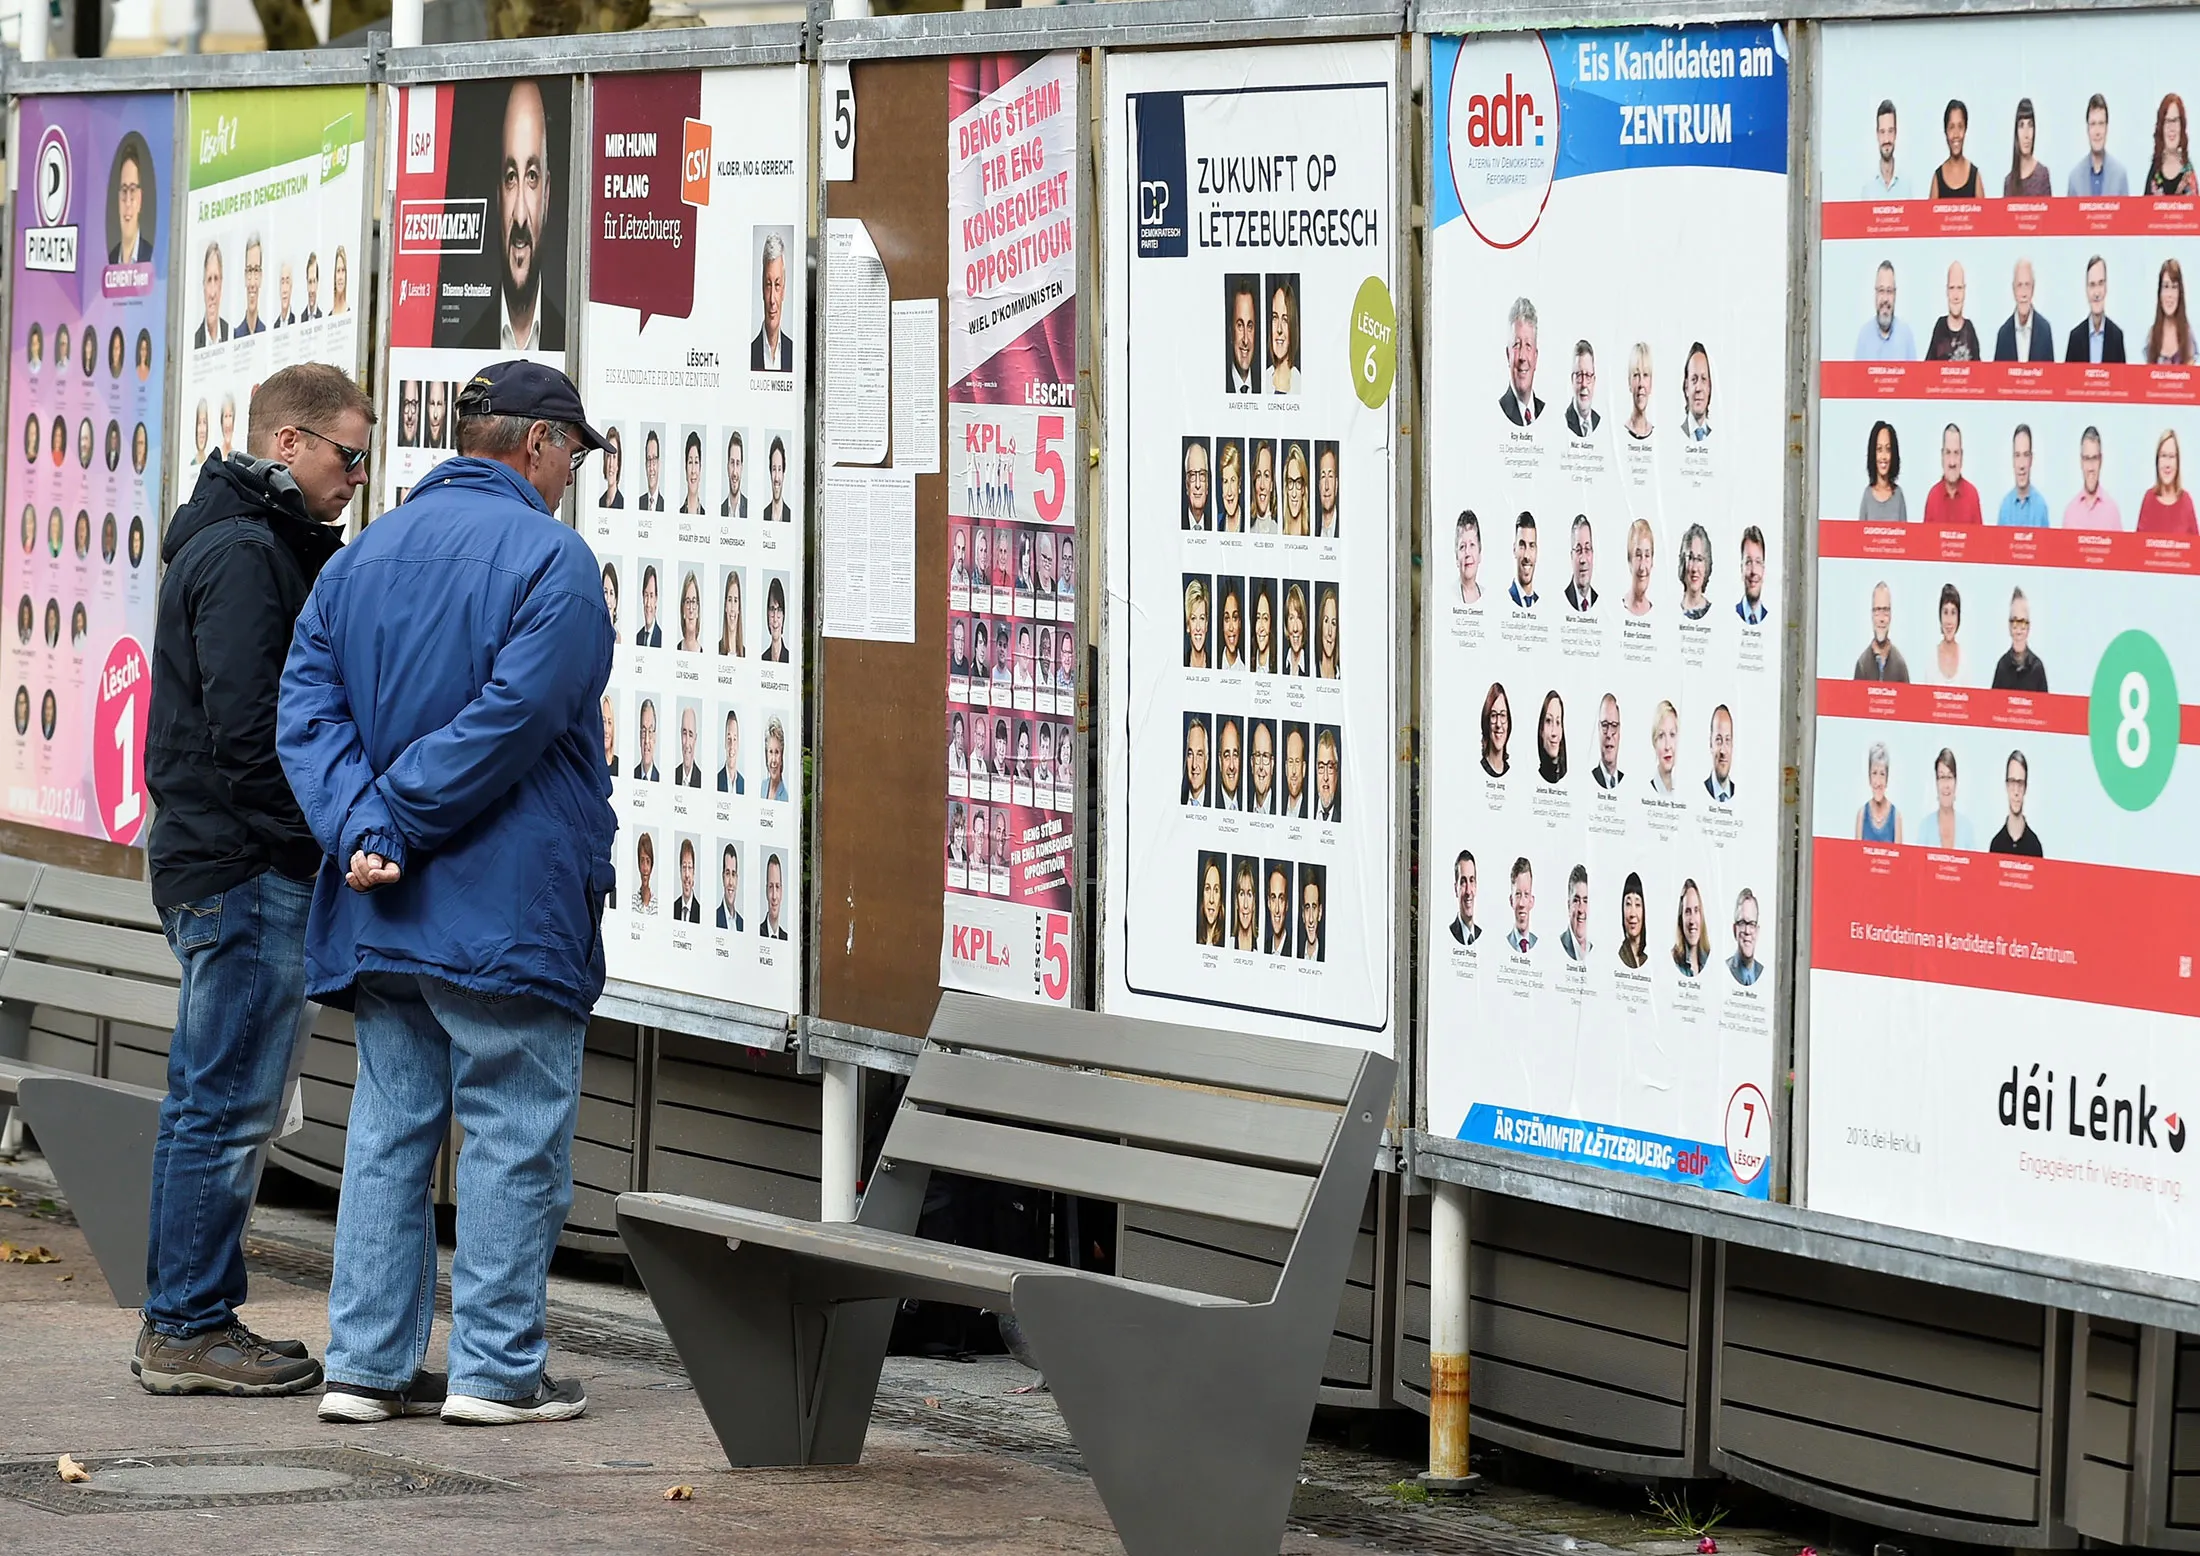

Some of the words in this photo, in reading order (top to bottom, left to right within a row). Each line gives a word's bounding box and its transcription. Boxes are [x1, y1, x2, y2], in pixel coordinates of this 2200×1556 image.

[1578, 42, 1609, 82] Eis
[1614, 38, 1734, 81] Kandidaten
[1739, 46, 1774, 78] am
[834, 89, 851, 150] 5
[959, 108, 1002, 161] DENG
[1005, 78, 1062, 137] STËMM
[1619, 103, 1732, 145] ZENTRUM
[410, 132, 432, 157] LSAP
[605, 133, 626, 158] MIR
[625, 132, 657, 158] HUNN
[685, 146, 710, 183] CSV
[717, 160, 742, 178] KLOER,
[742, 160, 754, 176] NO
[754, 161, 760, 175] &
[761, 160, 795, 176] GERECHT.
[981, 153, 1008, 197] FIR
[1010, 136, 1044, 182] ENG
[1197, 154, 1298, 194] ZUKUNFT
[1306, 153, 1337, 192] OP
[604, 174, 612, 199] E
[612, 173, 650, 199] PLANG
[1140, 181, 1169, 226] DP
[198, 201, 210, 223] ÄR
[210, 194, 239, 218] EQUIPE
[240, 191, 252, 211] FIR
[962, 170, 1068, 252] KONSEQUENT
[1199, 201, 1378, 247] LËTZEBUERGESCH
[404, 213, 480, 241] ZESUMMEN!
[604, 211, 619, 240] fir
[619, 211, 684, 249] Lëtzebuerg.
[1140, 226, 1181, 238] DEMOKRATESCH
[1140, 238, 1159, 249] PARTEI
[28, 235, 74, 264] PIRATEN
[965, 217, 1073, 298] OPPOSITIOUN
[105, 269, 132, 288] CLEMENT
[425, 282, 431, 297] 3
[463, 282, 493, 298] Schneider
[968, 313, 991, 336] WIEL
[991, 279, 1064, 326] D'KOMMUNISTEN
[1357, 312, 1392, 345] LËSCHT
[686, 348, 713, 368] LËSCHT
[714, 353, 720, 368] 4
[1363, 344, 1377, 384] 6
[605, 368, 616, 384] EIS
[616, 368, 657, 386] KANDIDATE
[657, 371, 669, 386] FIR
[669, 371, 685, 387] DEN
[684, 372, 720, 388] ZENTRUM
[771, 379, 794, 392] WISELER
[1024, 378, 1075, 407] LËSCHT
[965, 423, 1007, 454] KPL
[1033, 415, 1067, 523] 5
[103, 651, 141, 703] Lëscht
[2115, 671, 2152, 769] 8
[114, 693, 141, 833] 1
[8, 785, 86, 824] www.2018.lu
[1023, 825, 1041, 844] DENG
[1010, 850, 1022, 867] FIR
[1021, 846, 1036, 863] ENG
[952, 924, 1000, 966] KPL
[1034, 911, 1042, 996] LËSCHT
[1042, 912, 1069, 1001] 5
[1850, 921, 1865, 941] Eis
[1936, 935, 1944, 948] a
[1944, 933, 1995, 956] Kandidate
[1995, 937, 2008, 956] fir
[2008, 940, 2030, 959] den
[2030, 942, 2079, 965] Zentrum.
[1743, 1102, 1755, 1139] 7
[1998, 1063, 2054, 1132] déi
[2069, 1072, 2158, 1149] Lénk
[1493, 1109, 1514, 1141] ÄR
[1677, 1145, 1711, 1176] adr
[1734, 1149, 1761, 1168] LËSCHT
[2086, 1158, 2101, 1181] fir
